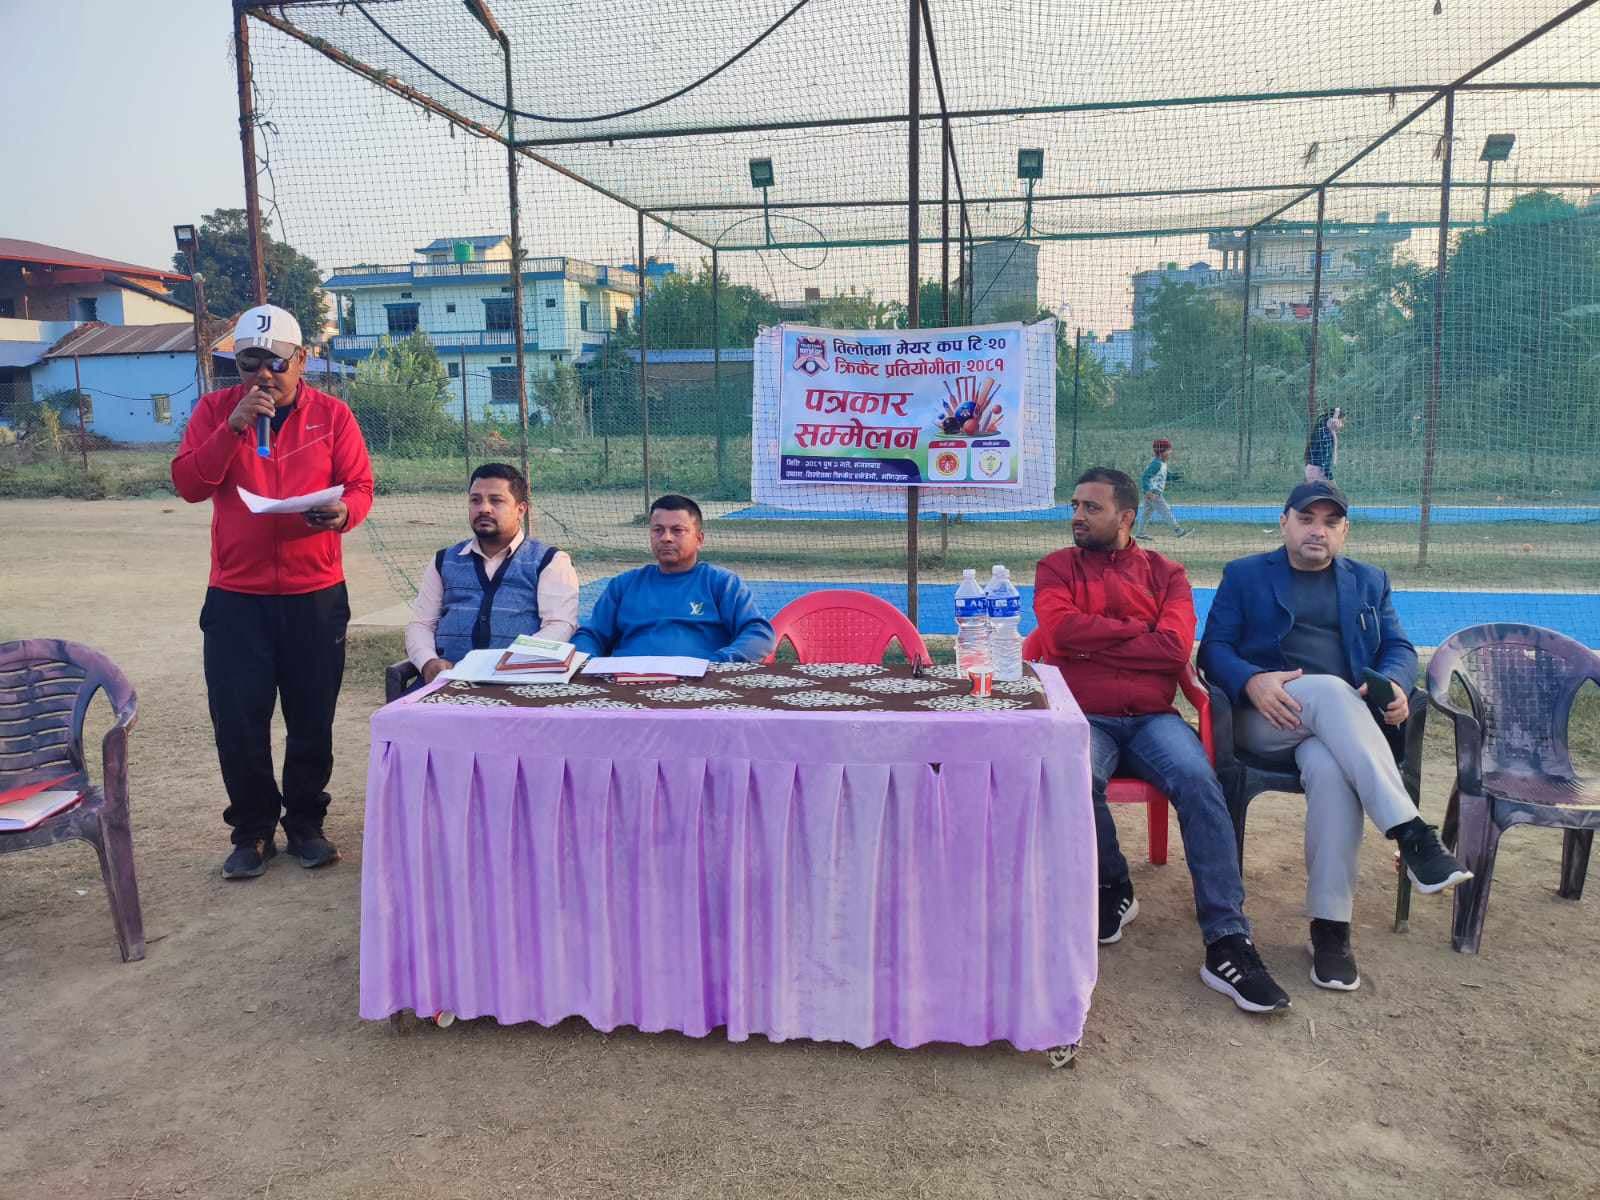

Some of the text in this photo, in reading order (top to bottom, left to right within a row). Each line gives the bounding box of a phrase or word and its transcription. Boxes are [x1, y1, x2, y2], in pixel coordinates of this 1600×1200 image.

[832, 335, 1007, 357] तिलोत्तमा मेयर कप टि-२०
[834, 357, 881, 377] क्रिकेट
[805, 389, 914, 416] पत्रकार
[794, 417, 922, 449] सम्मेलन
